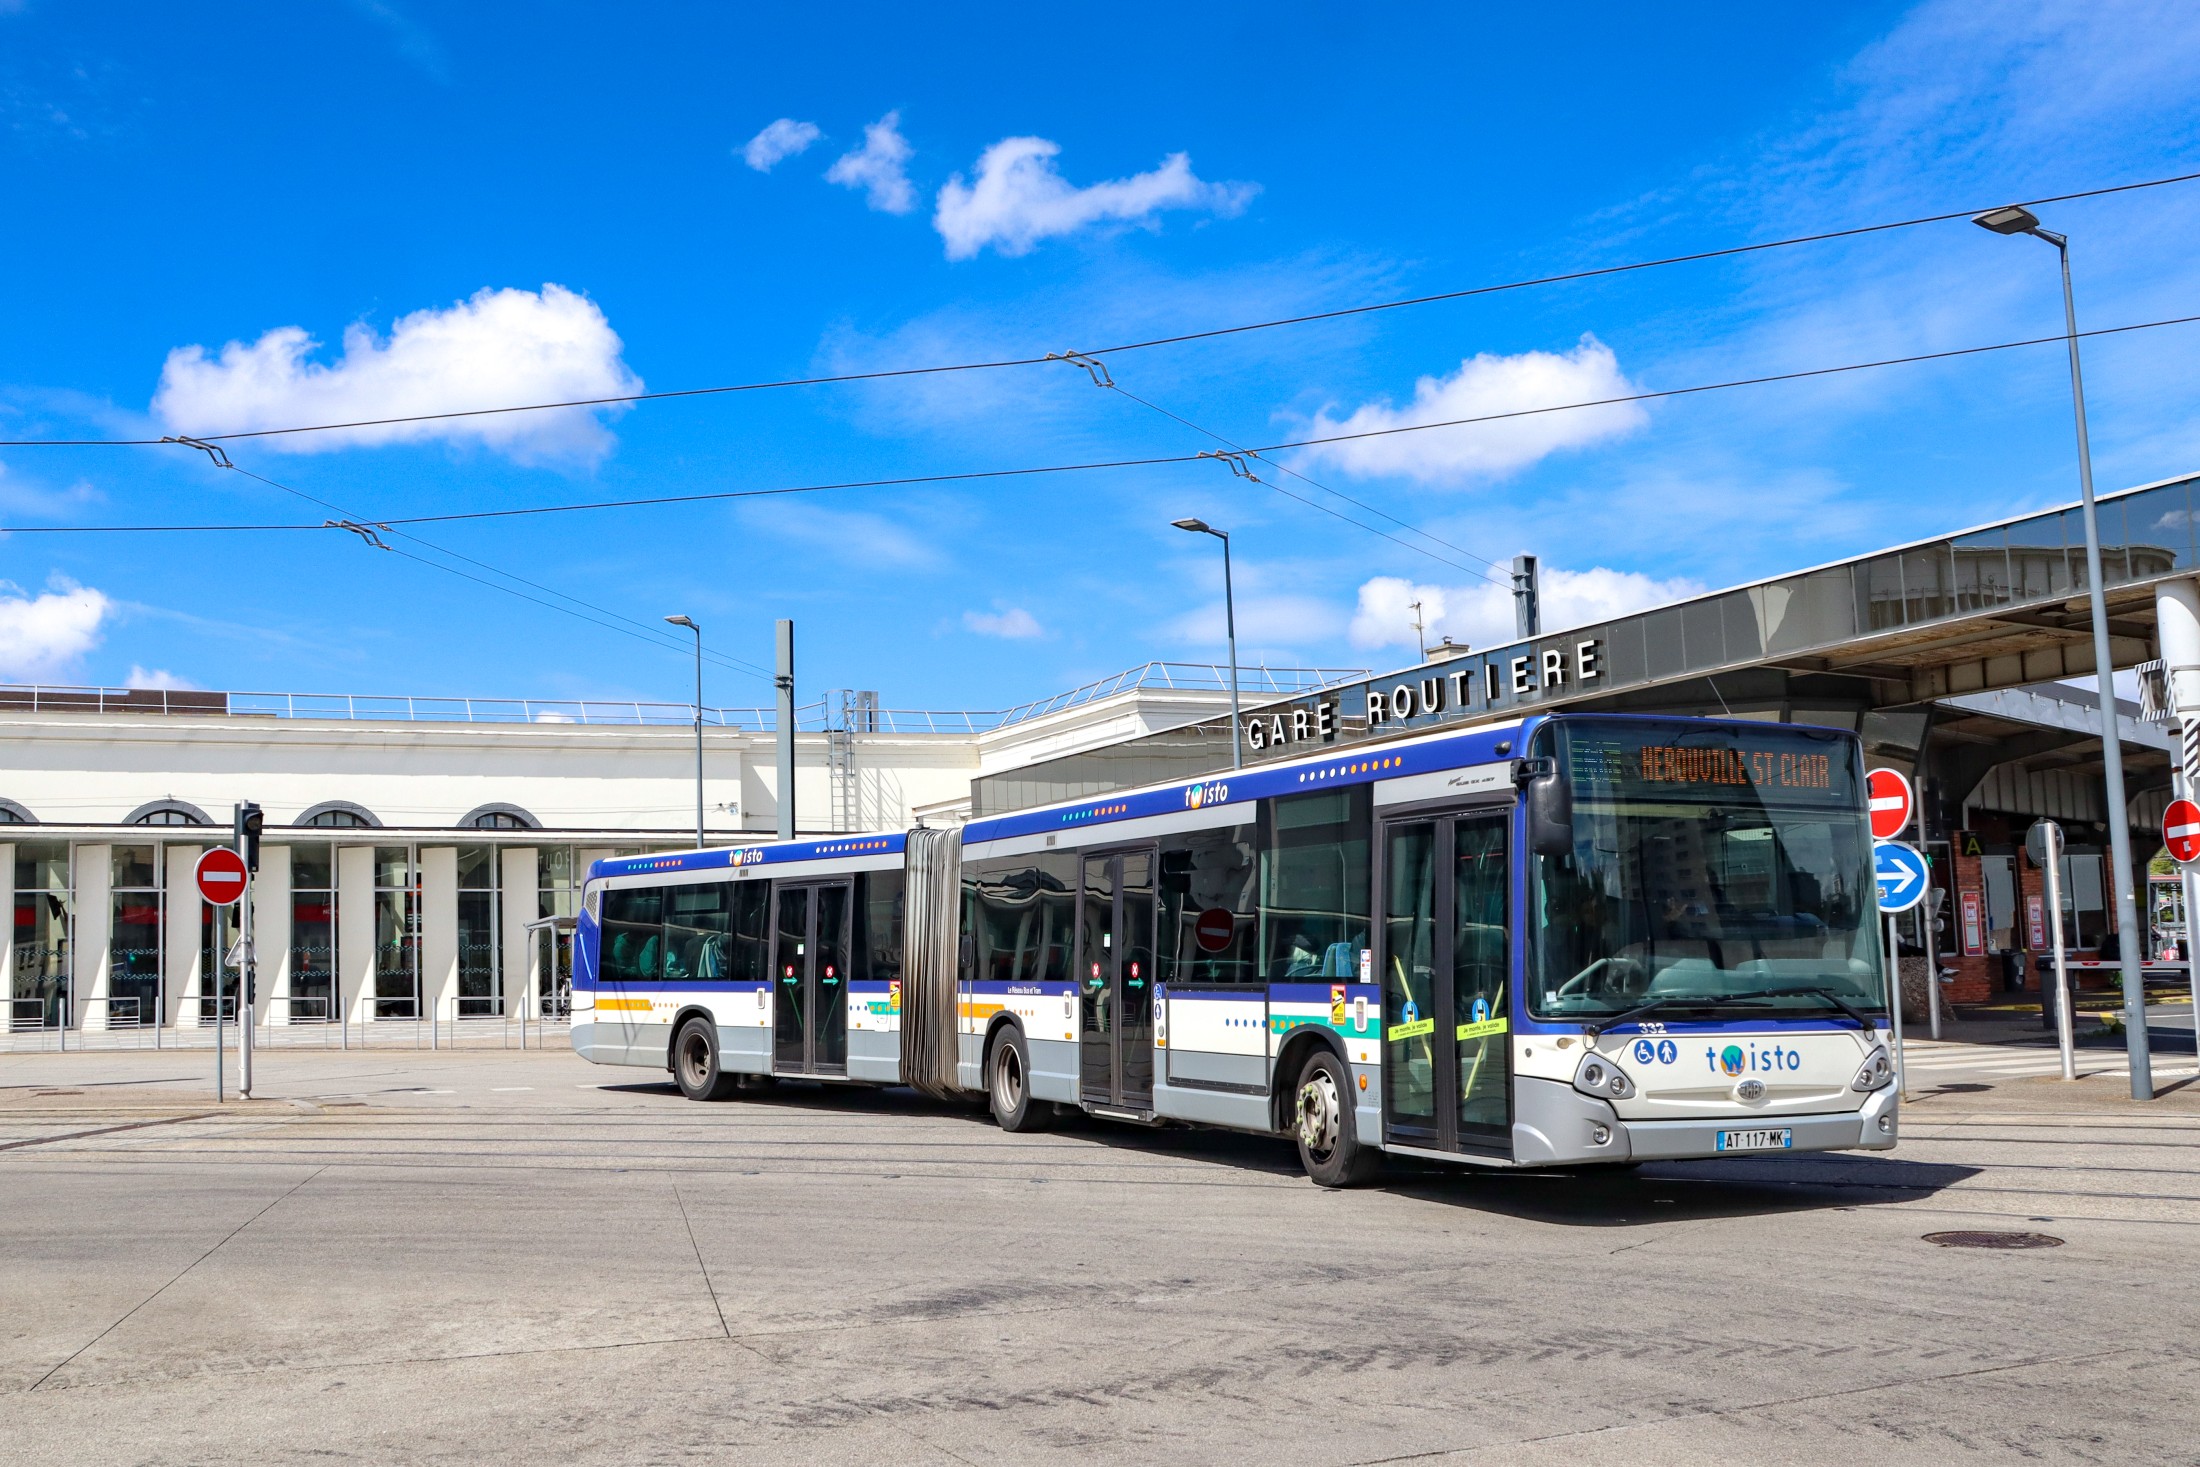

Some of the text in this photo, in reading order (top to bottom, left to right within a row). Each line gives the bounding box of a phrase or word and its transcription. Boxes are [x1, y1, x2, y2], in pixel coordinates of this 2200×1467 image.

[1248, 639, 1600, 750] GARE ROUTIERE
[1641, 746, 1829, 788] HEROUVILLE ST CLAIR
[1185, 781, 1228, 809] twisto
[729, 848, 762, 866] twisto
[1966, 837, 1982, 855] A
[1638, 1022, 1667, 1034] 332
[1706, 1042, 1800, 1078] twisto
